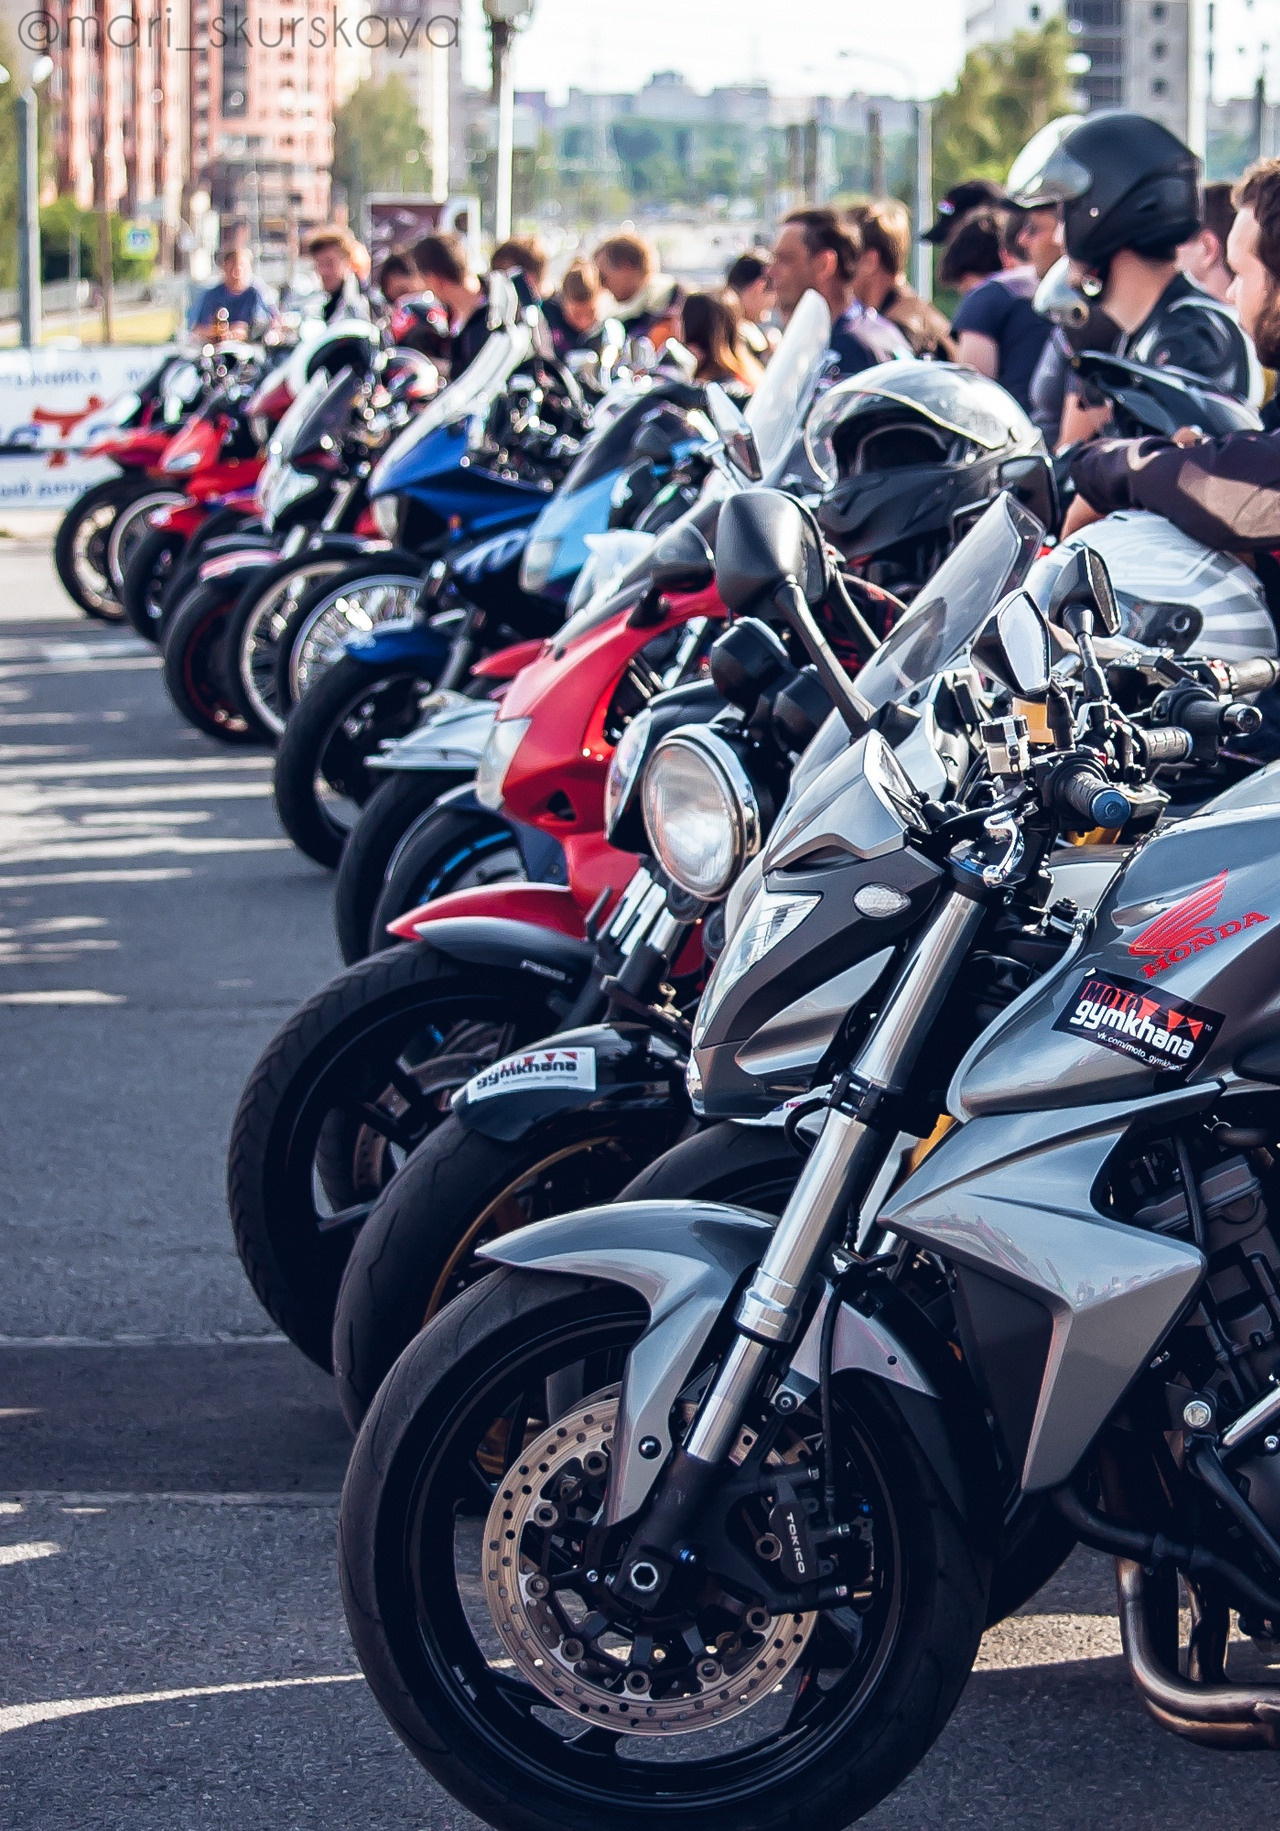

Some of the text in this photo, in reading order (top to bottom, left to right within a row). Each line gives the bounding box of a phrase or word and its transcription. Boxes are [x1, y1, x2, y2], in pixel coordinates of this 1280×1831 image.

[1141, 911, 1270, 979] HONDA
[1069, 999, 1195, 1059] gymkhana
[476, 1060, 578, 1090] gymkhana
[786, 1512, 806, 1574] TOKICO
